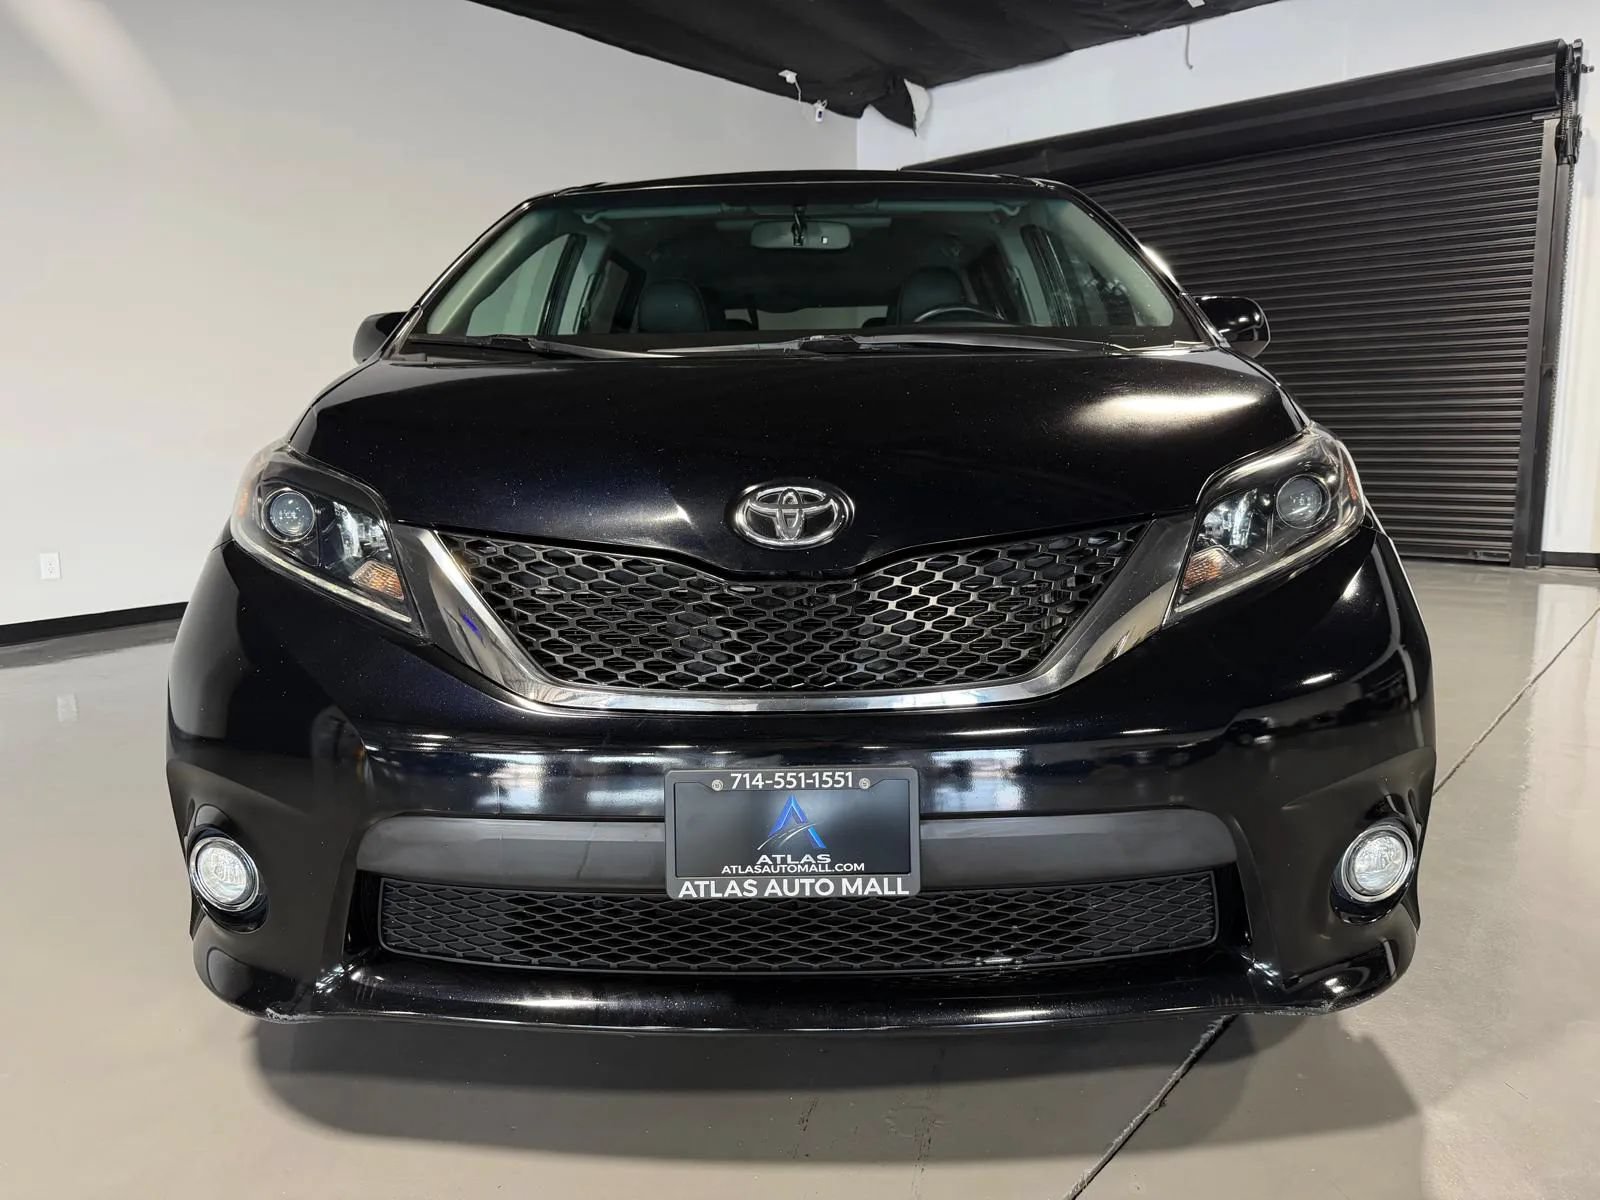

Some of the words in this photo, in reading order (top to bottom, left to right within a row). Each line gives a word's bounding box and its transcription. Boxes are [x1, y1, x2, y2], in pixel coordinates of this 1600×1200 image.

[730, 771, 853, 790] 714-551-1551
[756, 853, 832, 865] ATLAS
[721, 862, 865, 874] ATLASAUTOMALL.COM
[678, 879, 758, 898] ATLAS
[763, 878, 835, 897] AUTO
[842, 877, 909, 896] MALL
